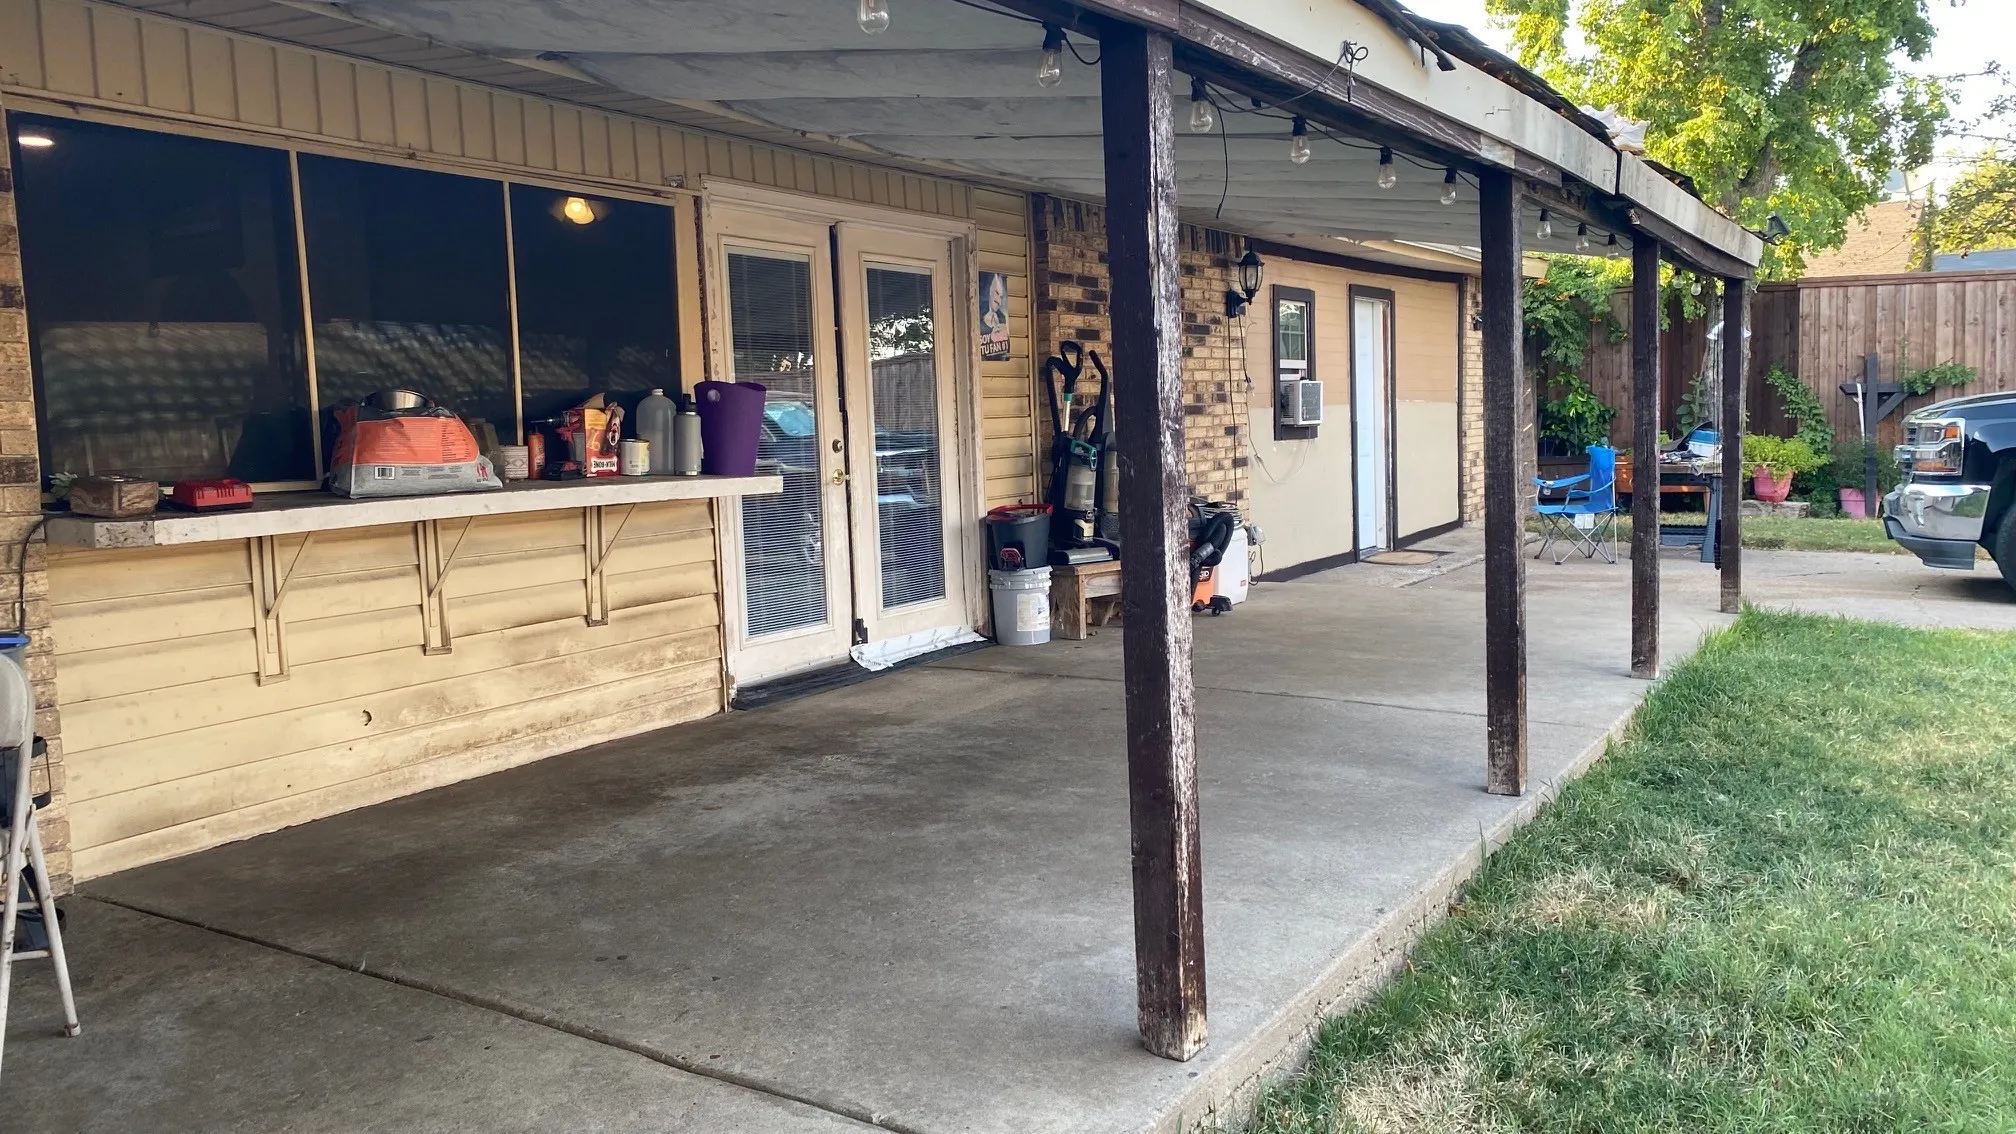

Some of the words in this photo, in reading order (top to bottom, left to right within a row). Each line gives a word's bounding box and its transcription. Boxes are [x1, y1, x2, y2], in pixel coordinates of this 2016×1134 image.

[980, 334, 991, 344] SOY
[980, 345, 989, 355] TU
[990, 342, 1001, 353] FAN
[593, 460, 615, 468] MILK-BONE
